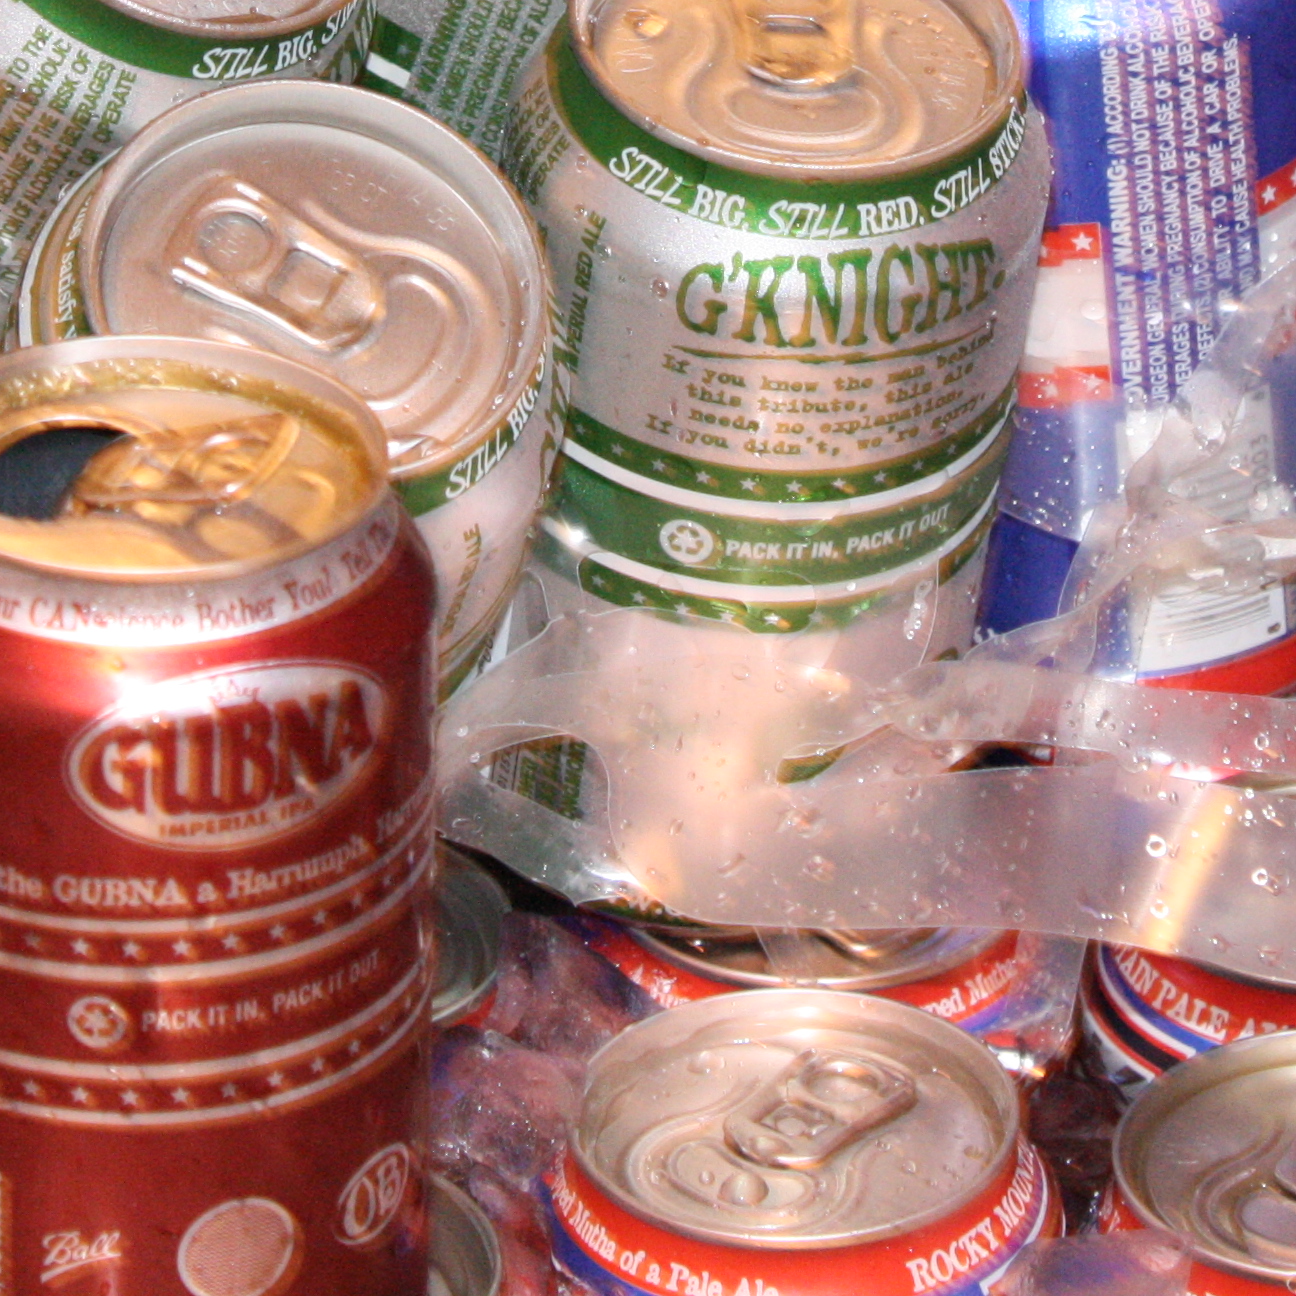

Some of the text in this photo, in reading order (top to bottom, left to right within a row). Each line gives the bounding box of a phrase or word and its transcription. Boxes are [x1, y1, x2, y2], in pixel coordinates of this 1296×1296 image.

[1143, 4, 1167, 41] RISK
[192, 44, 269, 79] STILL
[1150, 42, 1170, 76] THE
[1199, 48, 1218, 72] OR
[1127, 71, 1149, 119] DRINK
[1154, 78, 1174, 99] OF
[1176, 66, 1202, 147] ALCOHOLIC
[1200, 79, 1221, 114] CAR
[1131, 119, 1151, 150] NOT
[1154, 101, 1178, 170] BECAUSE
[1205, 121, 1222, 133] A
[1220, 33, 1255, 264] MAY CAUSE HEALTH PROBLEMS.
[608, 146, 686, 206] STILL
[758, 202, 850, 241] STILL
[930, 169, 991, 219] STILL
[990, 99, 1026, 180] STICK
[1099, 46, 1135, 265] WARNING: ACCORDING
[1132, 152, 1156, 212] SHOULD
[1183, 147, 1202, 167] OF
[1205, 140, 1227, 186] DRIVE
[1160, 172, 1186, 262] PREGNANCY
[1185, 170, 1211, 273] CONSUMPTION
[1210, 194, 1229, 217] TO
[570, 210, 608, 291] RED ALE
[1136, 214, 1159, 270] WOMEN
[1212, 224, 1234, 278] ABILITY
[56, 251, 76, 323] satisfy
[1167, 264, 1190, 320] DURING
[661, 354, 690, 374] If
[701, 368, 746, 389] you
[833, 375, 874, 391] the
[887, 363, 925, 386] man
[936, 330, 996, 370] behind
[685, 362, 974, 414] this tribute, this ale
[645, 412, 674, 435] If
[683, 428, 729, 449] you
[744, 436, 841, 456] didn't,
[856, 425, 920, 451] we're
[687, 407, 760, 432] needs
[774, 422, 806, 434] no
[444, 436, 509, 501] STILL
[725, 539, 781, 561] PACK
[786, 540, 806, 559] IT
[845, 529, 895, 554] PACK
[897, 519, 917, 540] IT
[918, 504, 951, 531] OUT
[200, 599, 276, 631] Bother
[98, 680, 375, 815] GUBNA
[159, 811, 270, 837] IMPERIAL
[54, 874, 193, 908] GUBNA
[197, 882, 218, 904] a
[227, 836, 372, 901] Harrumph
[142, 1010, 202, 1033] PACK
[207, 1007, 228, 1028] IT
[272, 981, 323, 1013] PACK
[327, 973, 344, 998] IT
[348, 950, 381, 987] OUT
[1154, 979, 1231, 1040] PALE
[41, 1231, 120, 1267] Ball
[568, 1200, 723, 1296] Mutha of a Pale
[906, 1221, 1000, 1293] ROCKY
